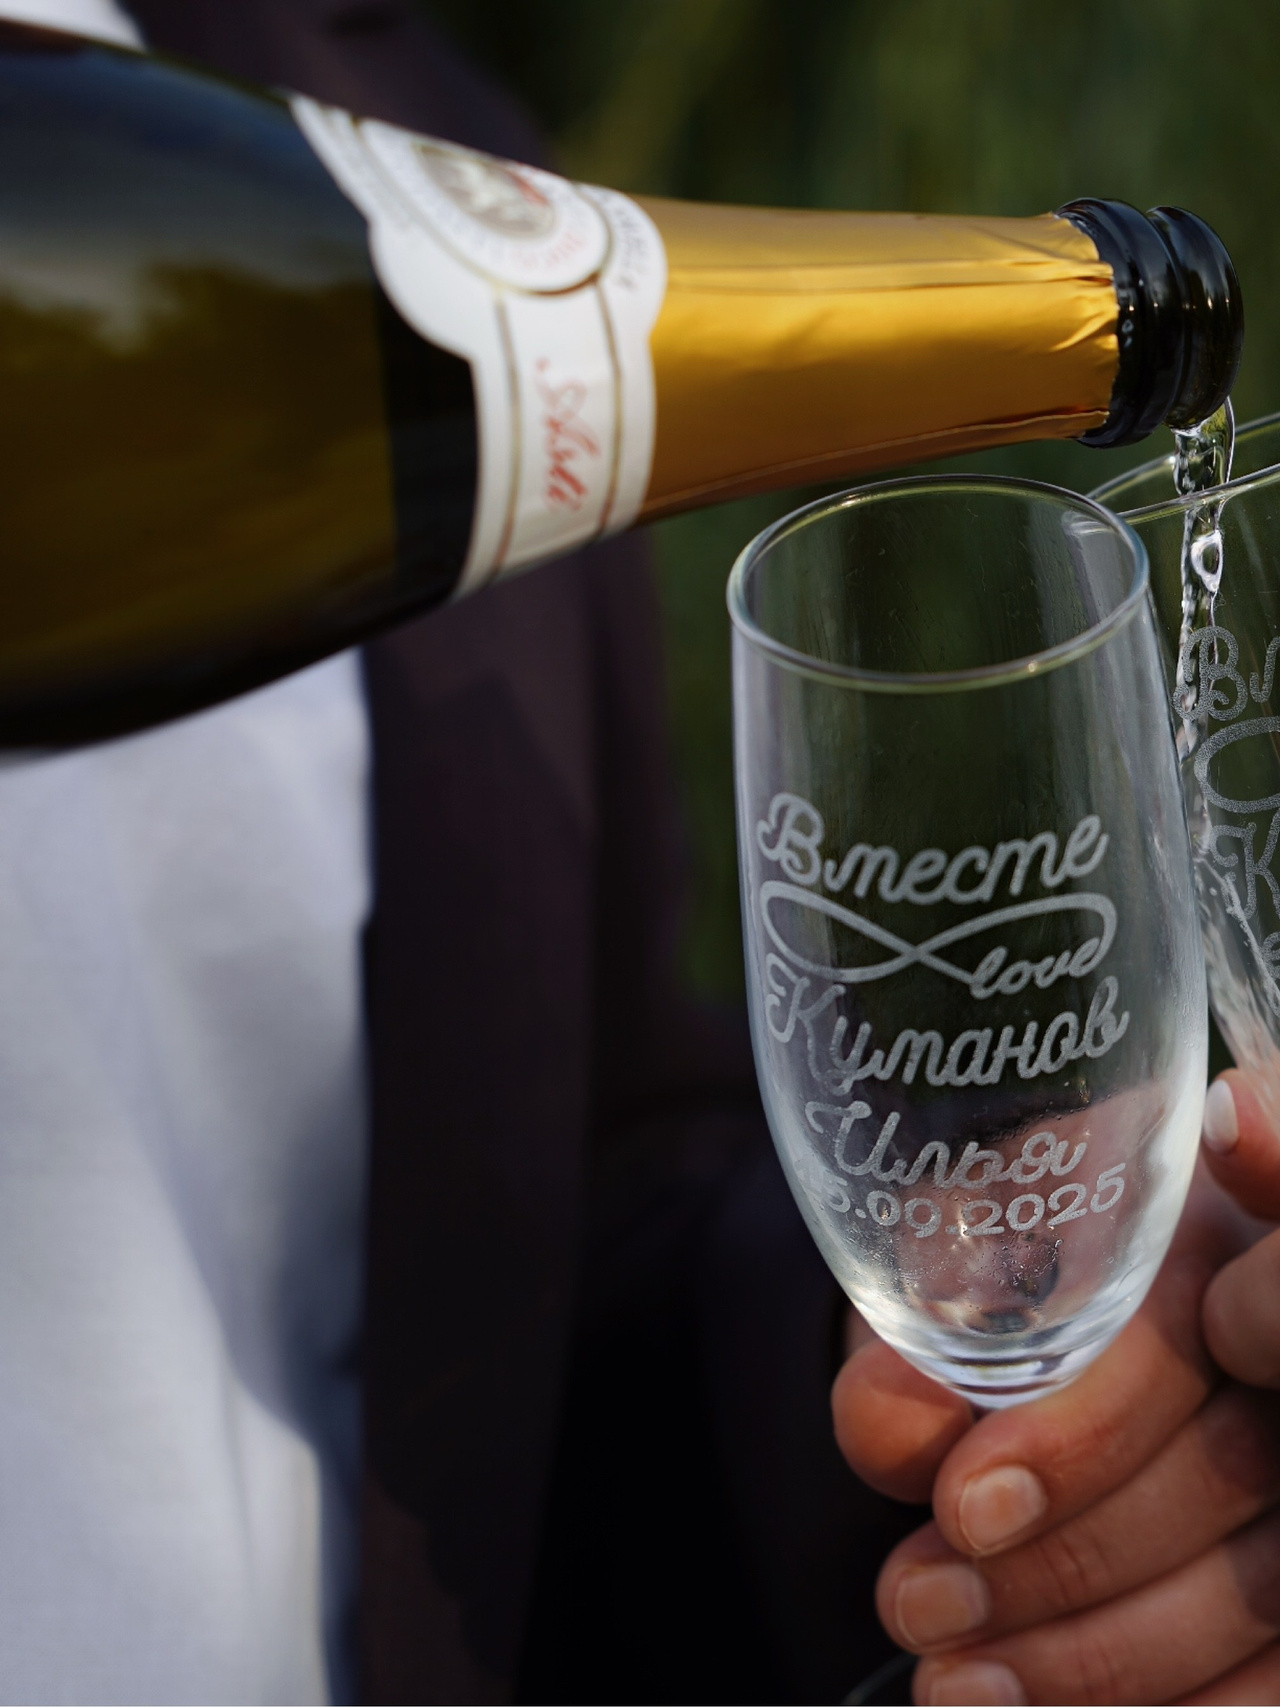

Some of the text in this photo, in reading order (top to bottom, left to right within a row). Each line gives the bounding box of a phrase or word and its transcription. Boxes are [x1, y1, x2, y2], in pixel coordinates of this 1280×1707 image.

[756, 792, 1109, 905] Вместе
[968, 937, 1102, 999] love
[764, 952, 1130, 1097] Куманов
[804, 1100, 1087, 1190] Илья
[800, 1162, 1126, 1239] 5.09.2025
